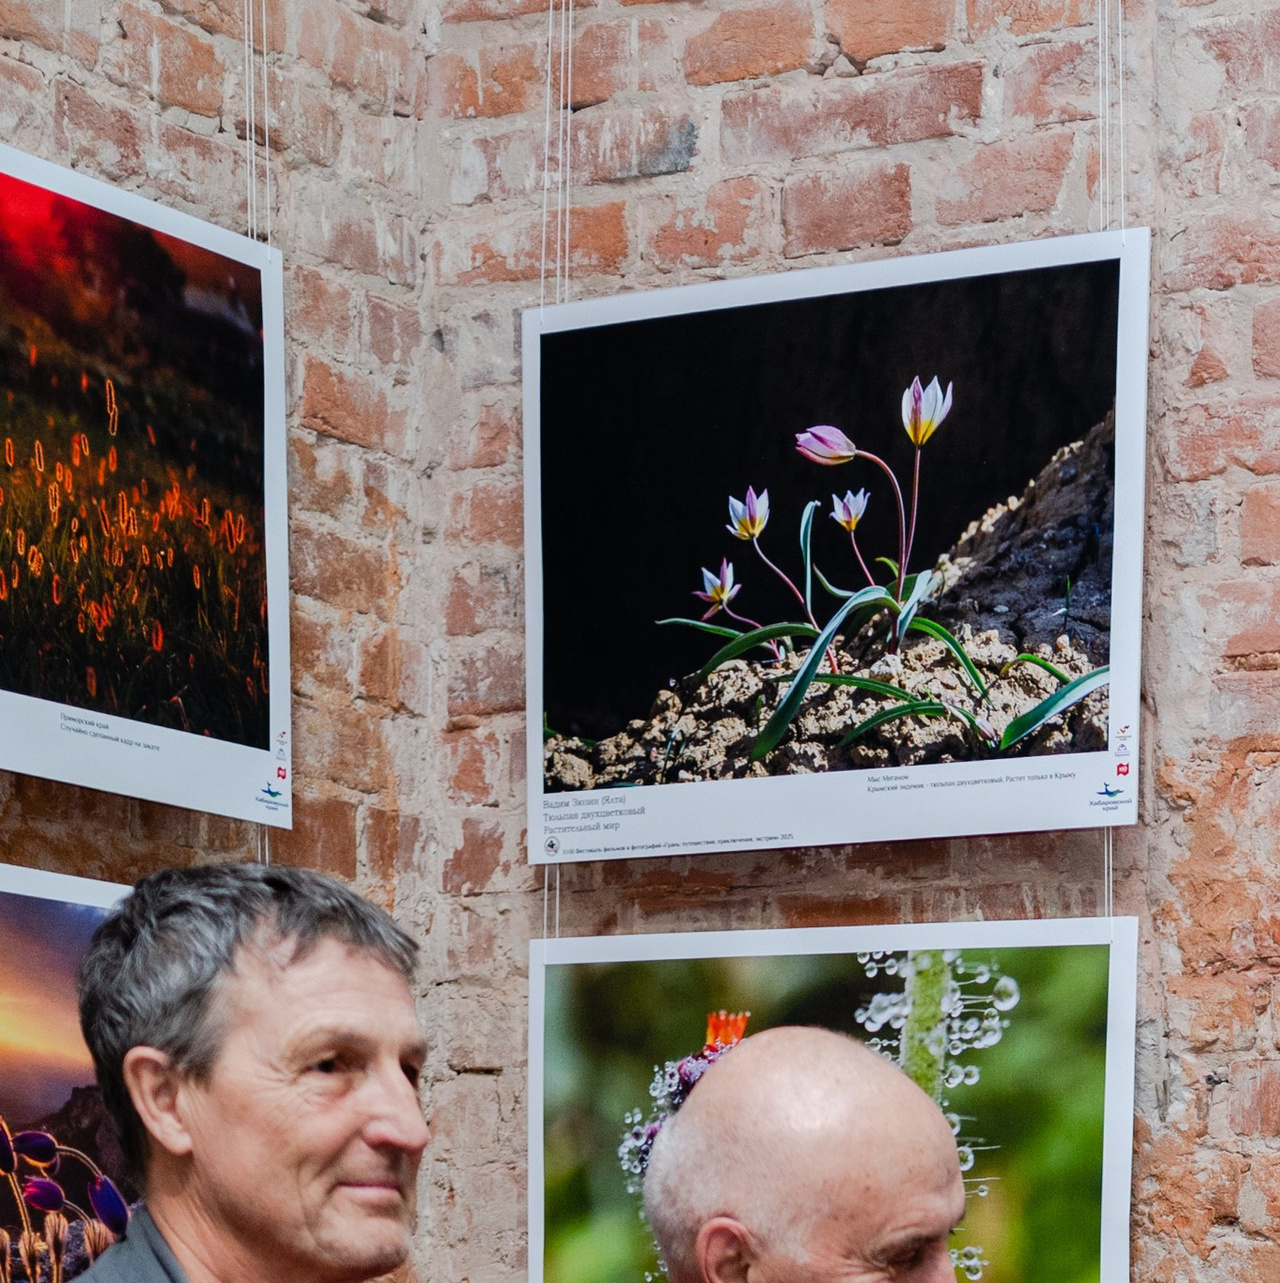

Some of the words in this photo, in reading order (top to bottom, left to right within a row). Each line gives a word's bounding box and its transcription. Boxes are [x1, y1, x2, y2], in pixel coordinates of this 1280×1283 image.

[1055, 772, 1076, 780] Крыму
[543, 812, 578, 822] Тюльпан
[544, 822, 600, 834] Растительный
[603, 822, 620, 832] мир
